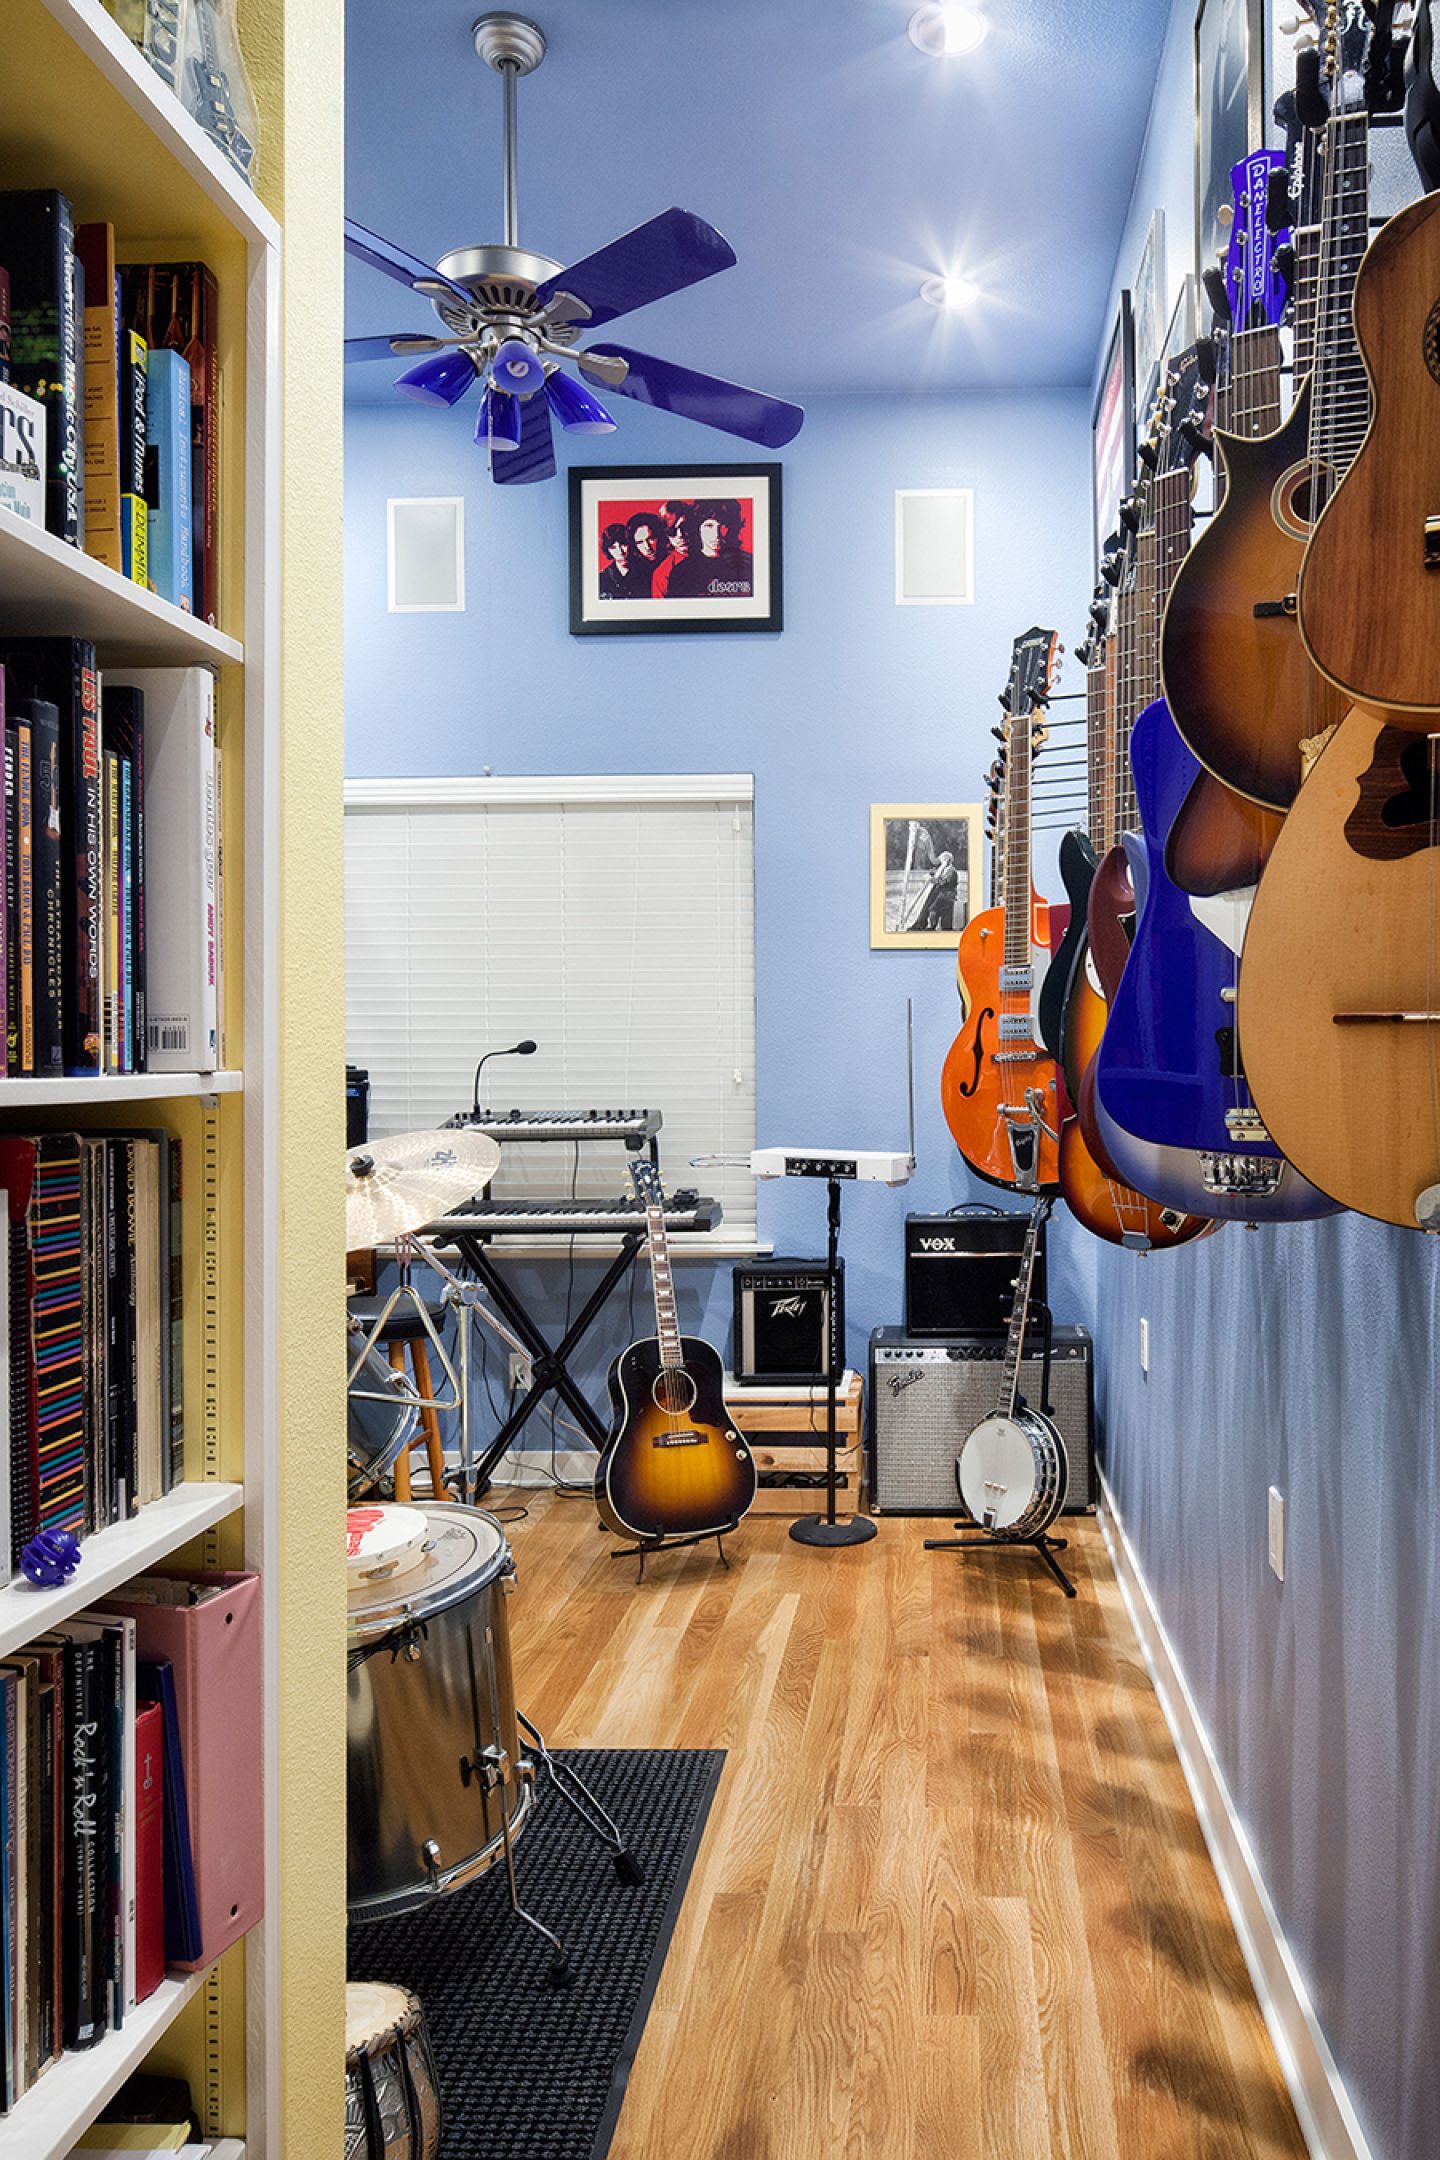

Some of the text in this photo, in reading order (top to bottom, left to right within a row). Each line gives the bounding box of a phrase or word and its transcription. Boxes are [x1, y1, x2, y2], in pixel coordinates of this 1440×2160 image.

[1287, 141, 1305, 201] Epiphone
[1251, 164, 1267, 292] DANELECTRO
[135, 370, 146, 417] iPod
[135, 418, 146, 434] &
[135, 434, 146, 495] iTunes
[5, 746, 14, 797] FENDER
[22, 741, 31, 760] THE
[82, 667, 97, 979] LES PAUL IN HIS OWN WORDS
[47, 888, 56, 998] CHRONICLES
[207, 903, 216, 939] ANDY
[55, 898, 63, 1030] STRATOCASTER
[127, 1142, 136, 1191] DAVID
[127, 1192, 136, 1248] BOWIE
[919, 1236, 956, 1251] VOX
[75, 1652, 83, 1717] DEFINITIVE
[86, 1650, 95, 1671] THE
[73, 1721, 98, 1768] Rock
[72, 1792, 97, 1838] Roll
[87, 1841, 96, 1913] COLLECTION
